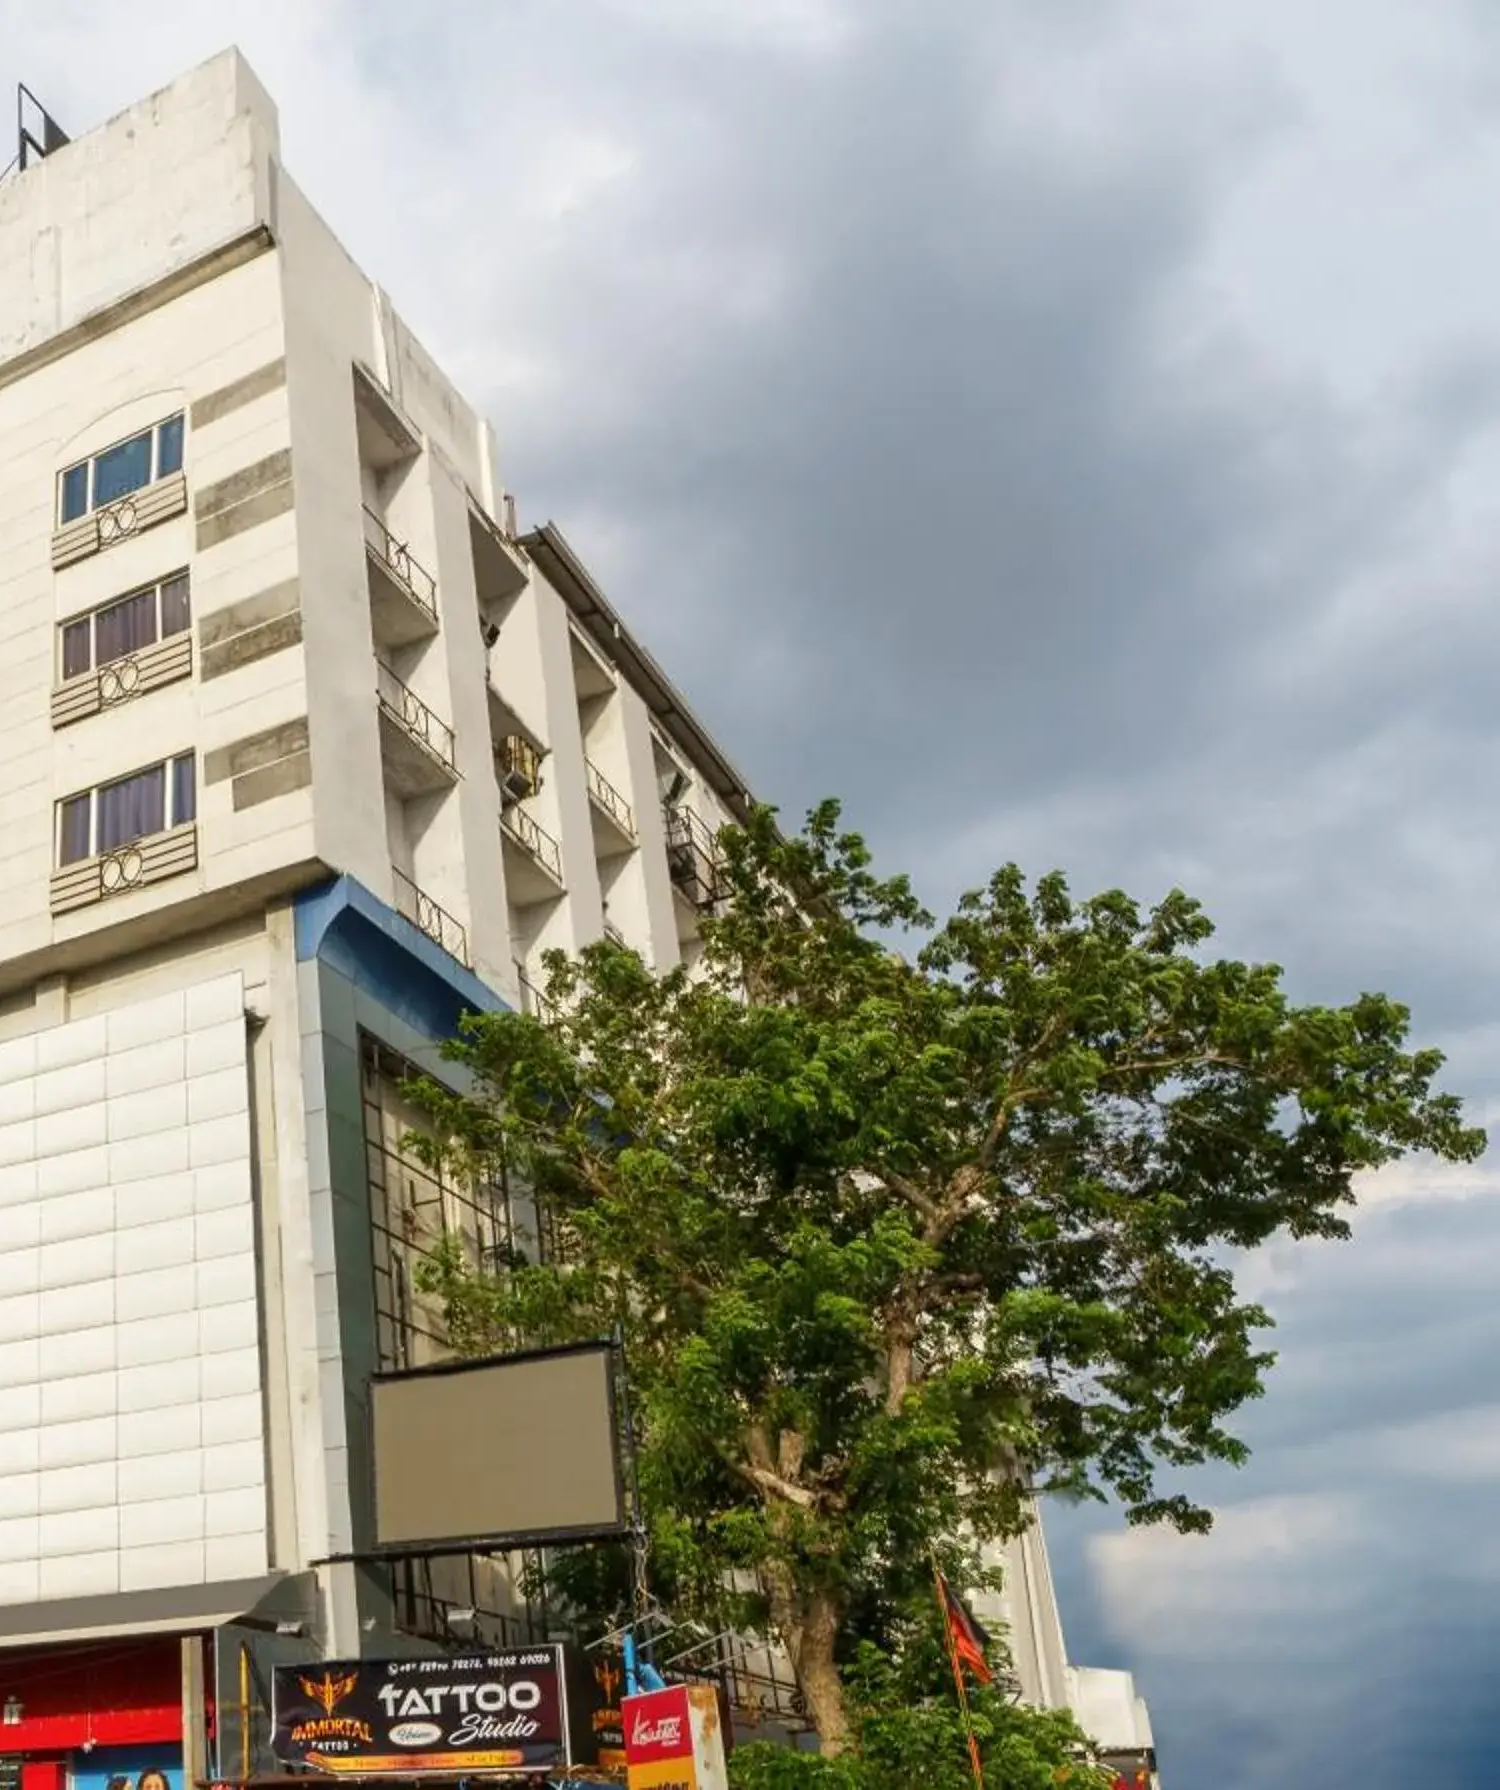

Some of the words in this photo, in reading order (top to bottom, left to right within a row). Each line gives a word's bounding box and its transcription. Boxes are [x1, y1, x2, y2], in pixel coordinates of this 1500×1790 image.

[377, 1681, 541, 1718] TATTOO
[291, 1717, 374, 1742] IMMORTAL
[448, 1713, 541, 1746] Studio
